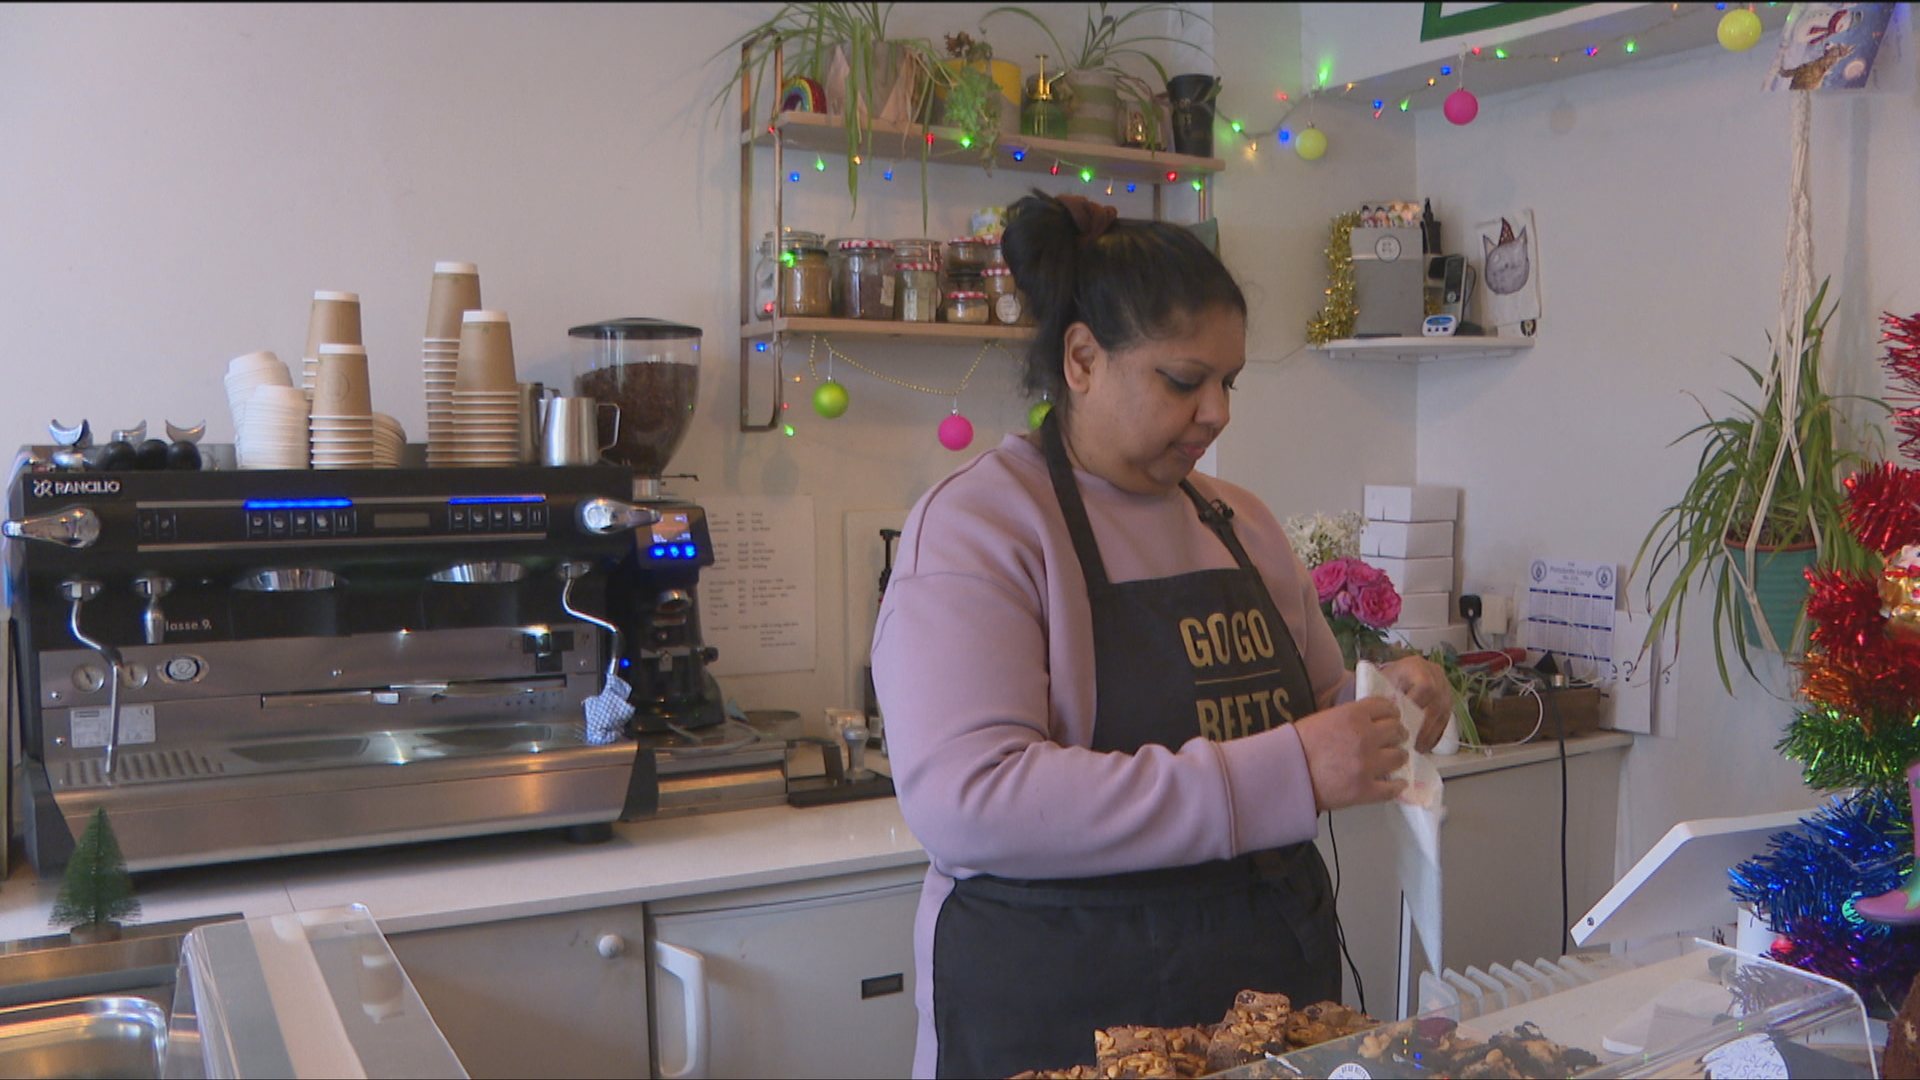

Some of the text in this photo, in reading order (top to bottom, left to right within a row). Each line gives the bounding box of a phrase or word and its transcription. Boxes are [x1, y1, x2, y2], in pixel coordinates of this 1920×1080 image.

[55, 480, 120, 494] RANCILIO
[165, 620, 199, 631] lasse
[1180, 608, 1274, 667] GOGO
[1196, 687, 1292, 742] BEETS
